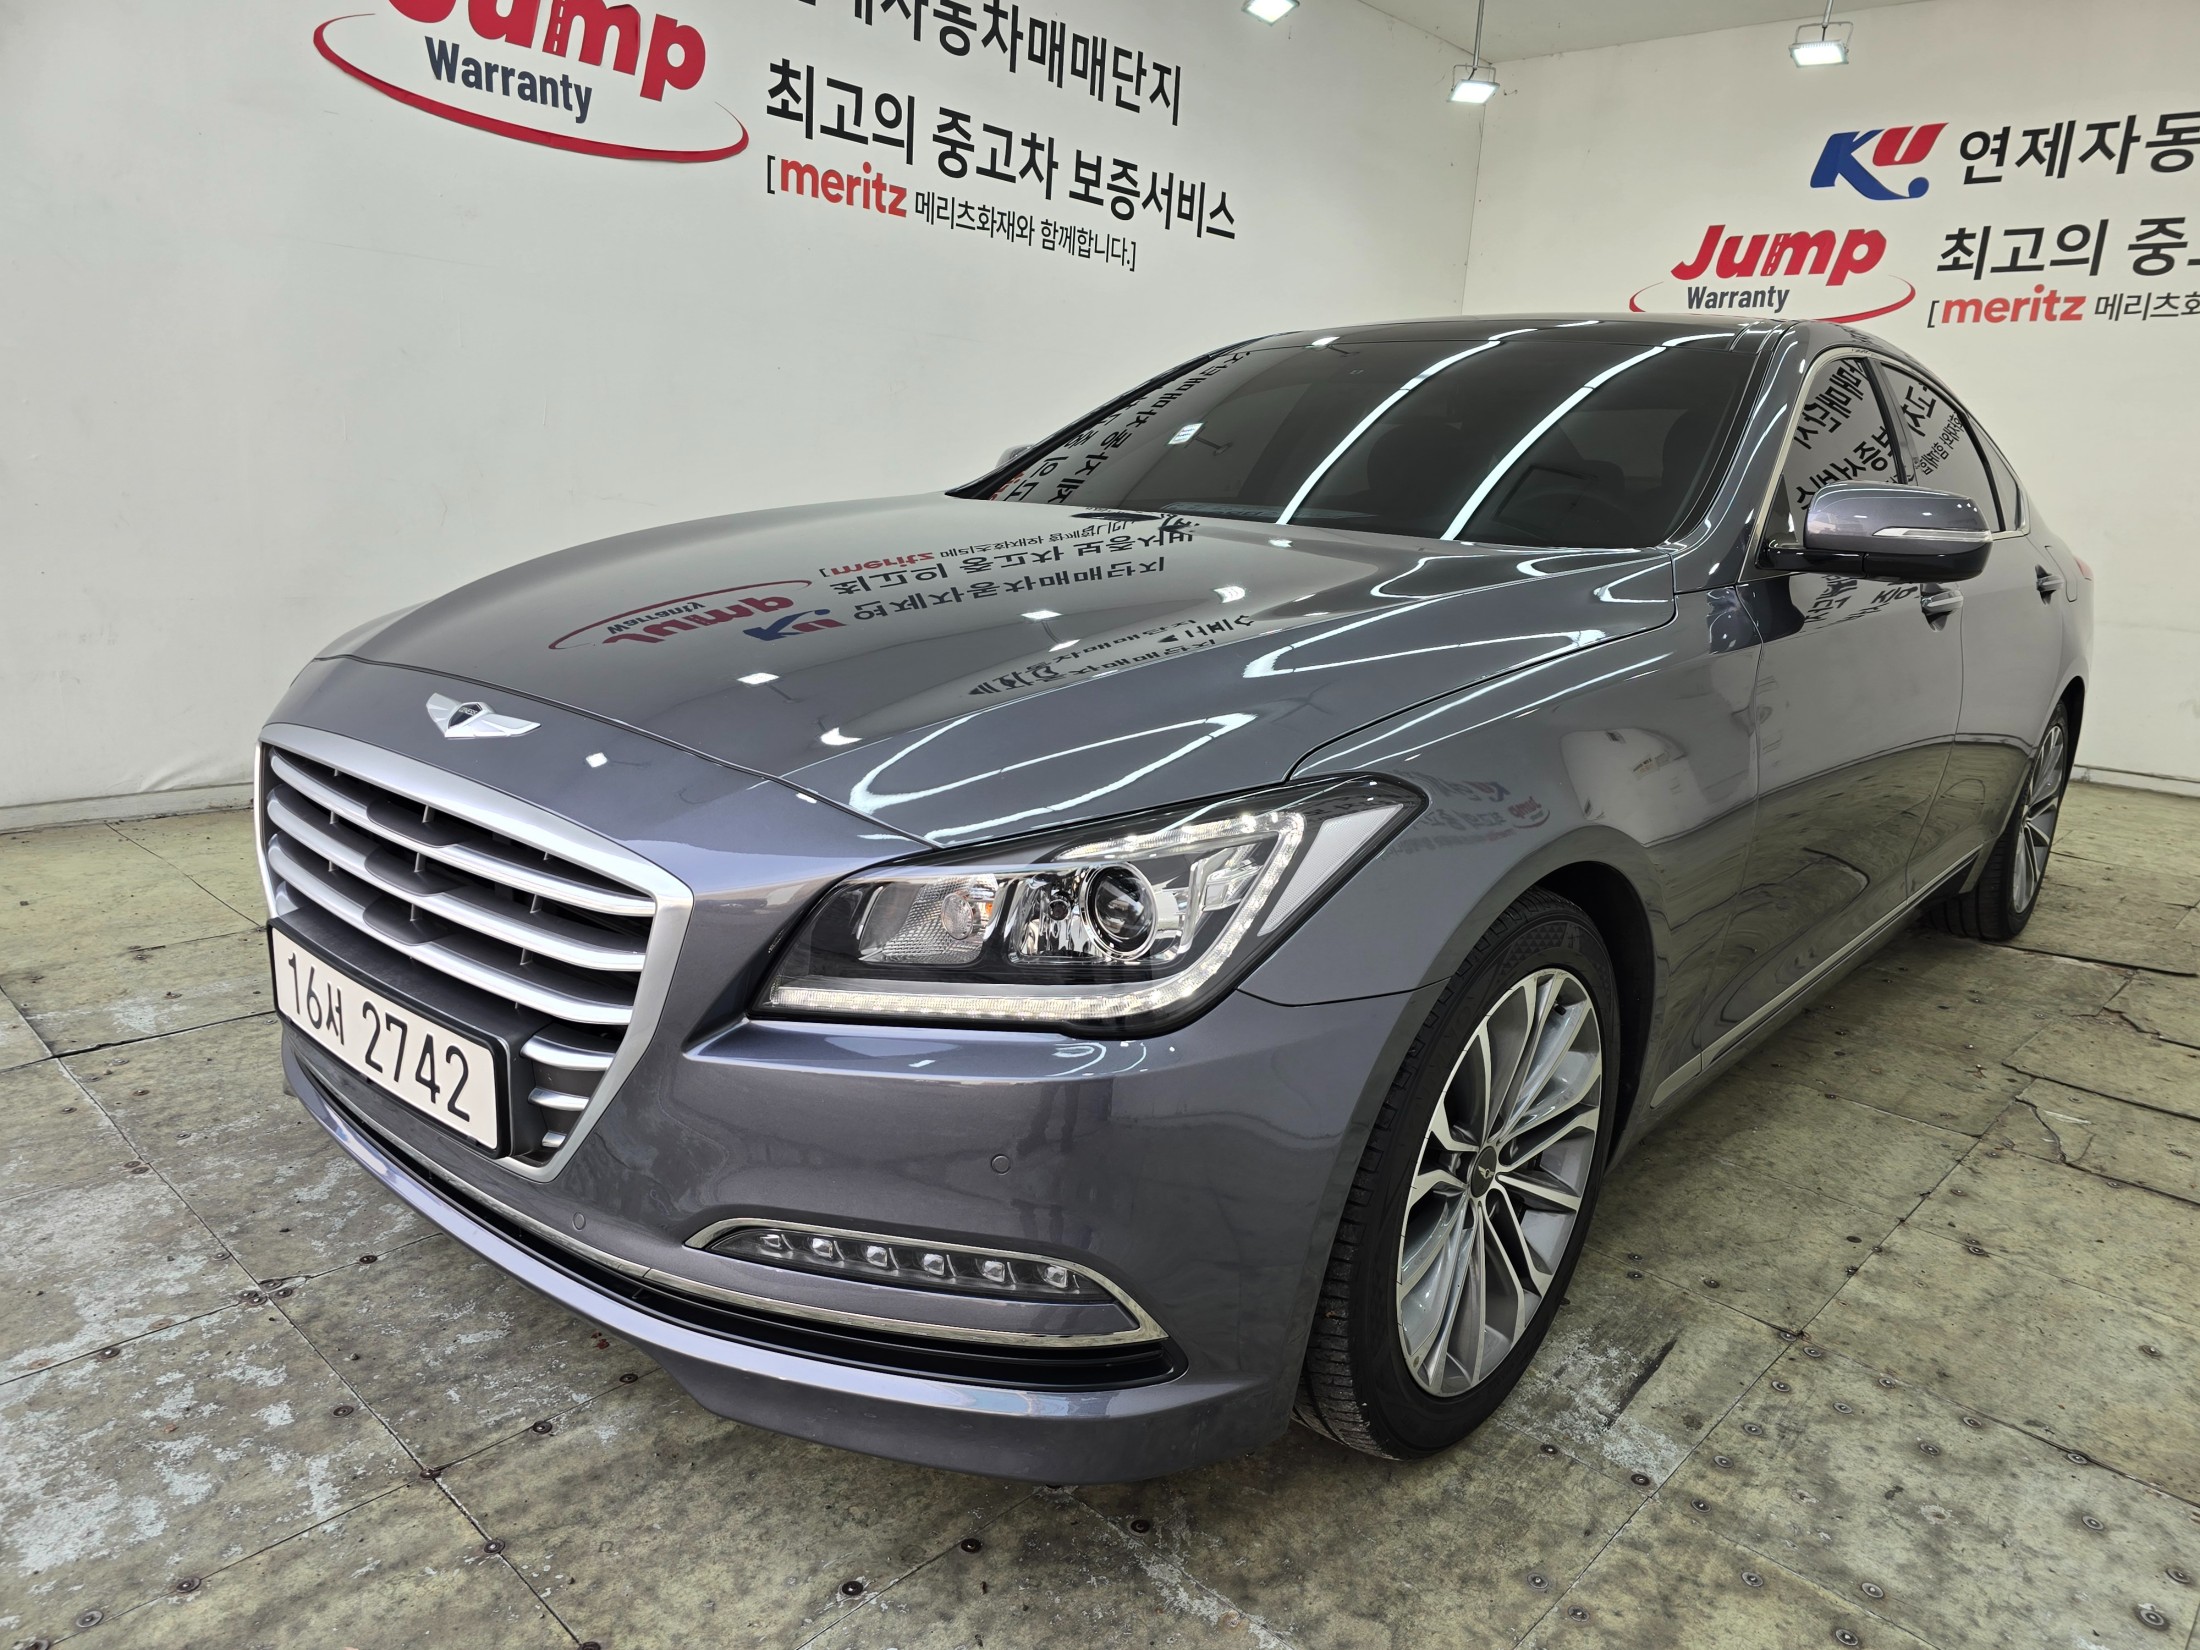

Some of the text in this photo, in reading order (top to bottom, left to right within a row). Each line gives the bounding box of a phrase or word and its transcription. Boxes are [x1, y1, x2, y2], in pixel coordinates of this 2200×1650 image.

[388, 0, 706, 102] ump
[424, 36, 592, 124] Warranty
[766, 58, 1236, 239] 최고의 중고차 보증서비스
[914, 191, 1035, 246] 메리츠화재와
[1040, 219, 1137, 272] 함께합니다.]
[1671, 224, 1887, 286] Jump
[1937, 217, 2200, 280] 최고의 중
[1687, 284, 1790, 313] Warranty
[288, 952, 470, 1123] 16서 2742
